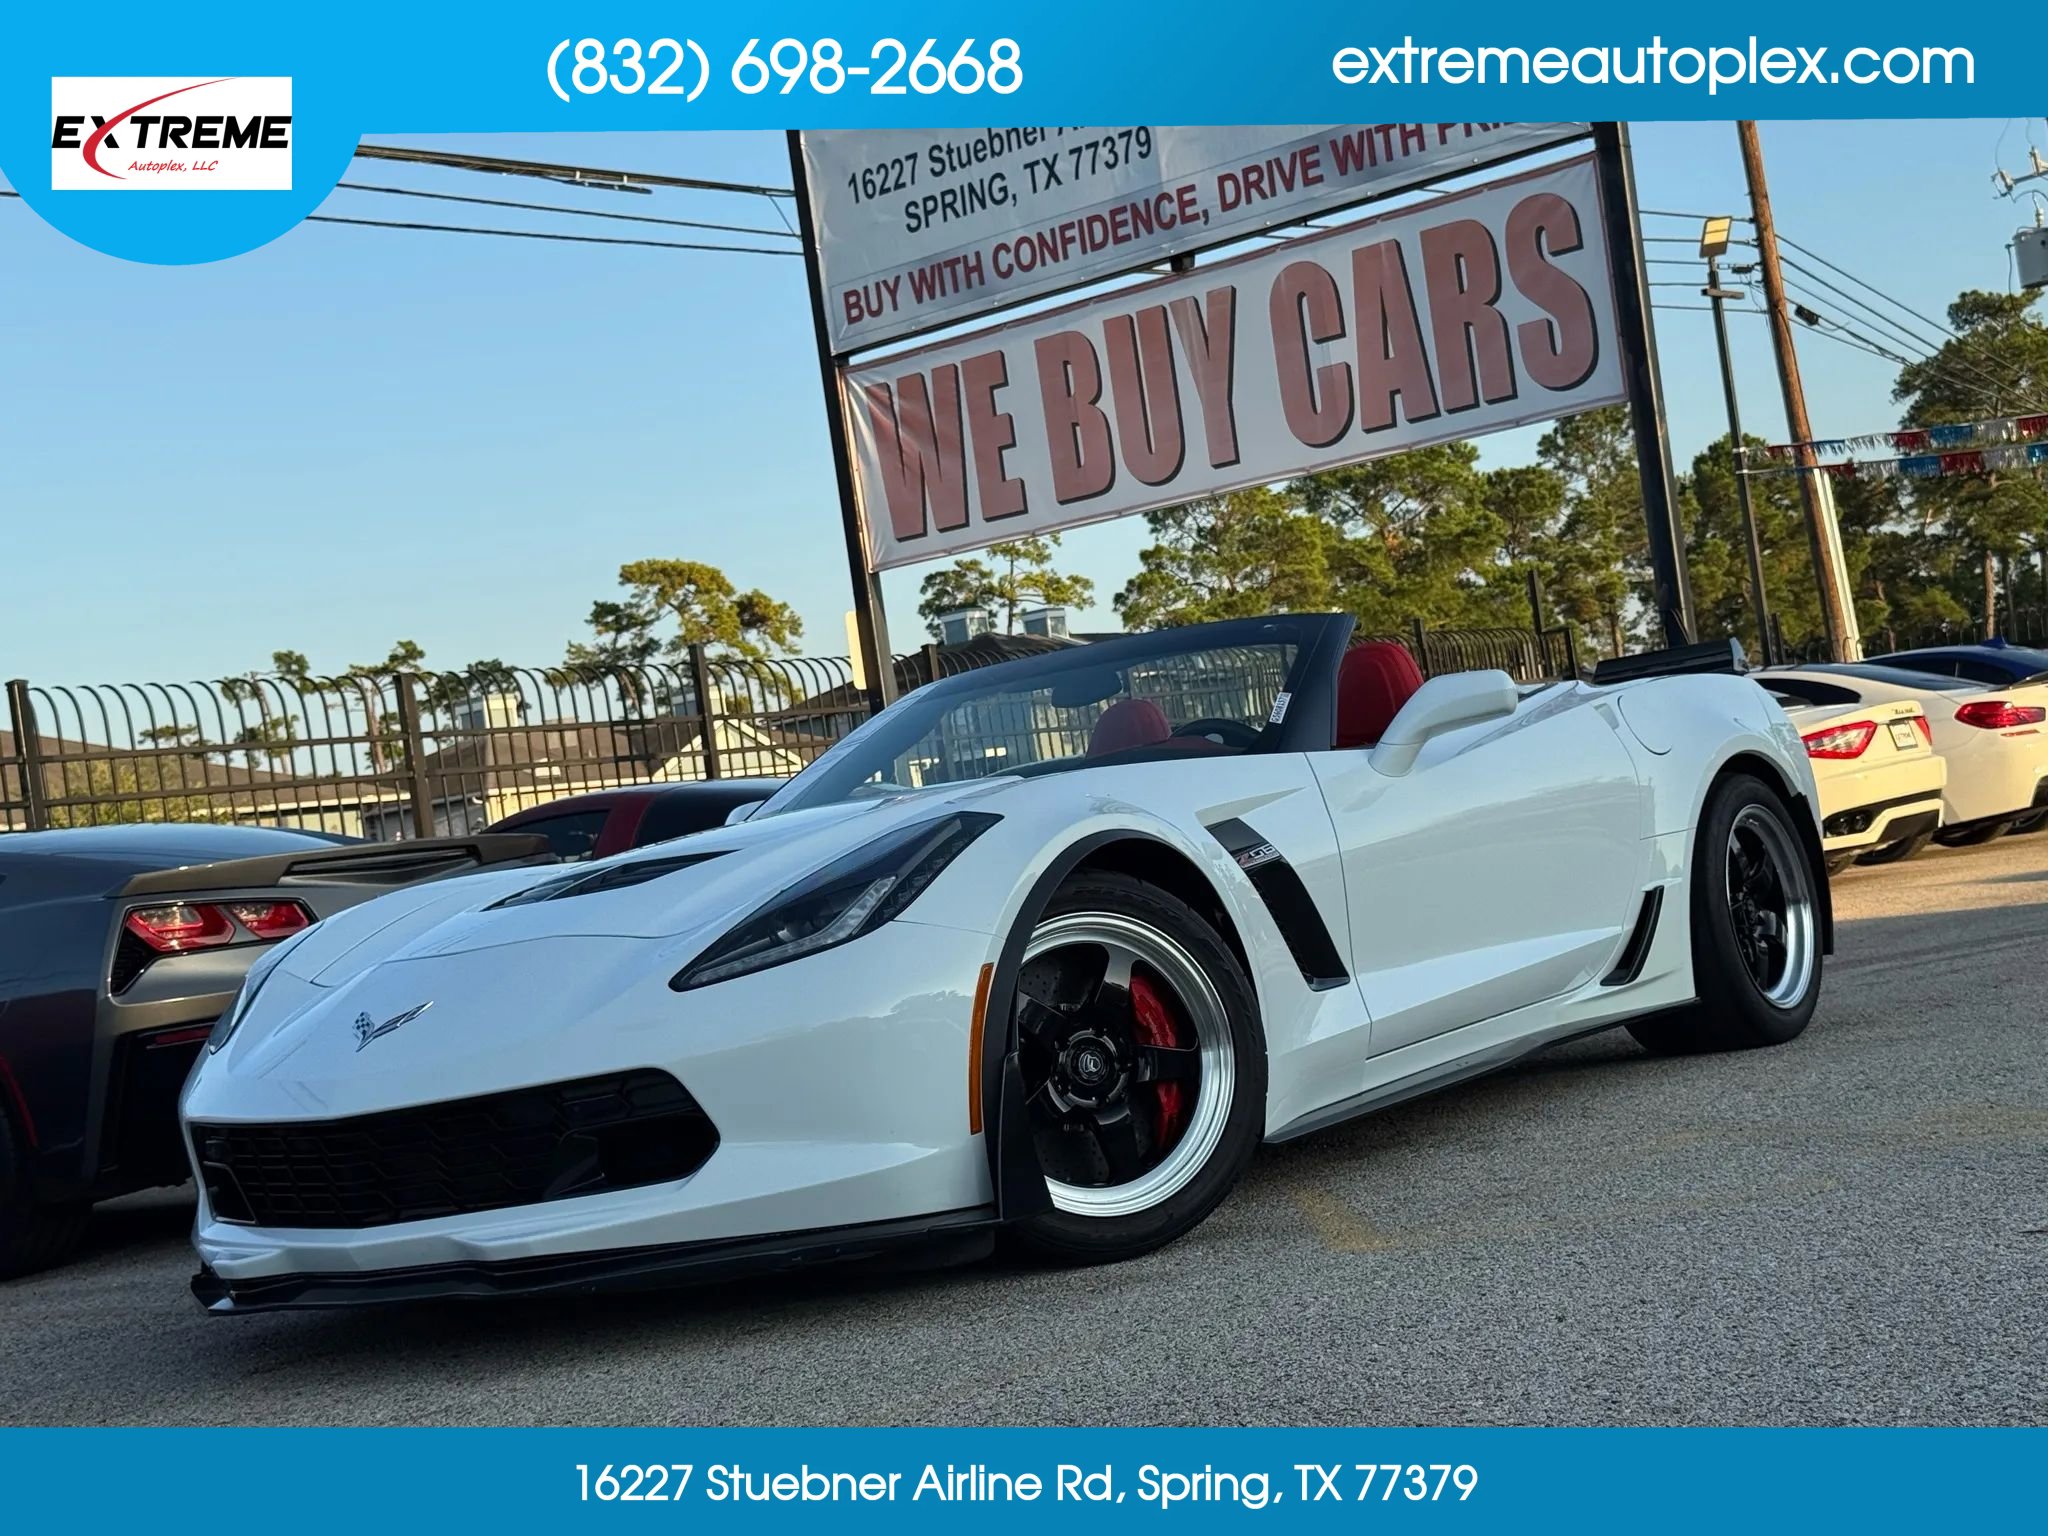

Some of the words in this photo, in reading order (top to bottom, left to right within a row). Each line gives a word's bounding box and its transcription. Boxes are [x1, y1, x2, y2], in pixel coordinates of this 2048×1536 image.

[843, 276, 901, 325] BUY
[908, 251, 985, 304] WITH
[992, 184, 1209, 280] CONFIDENCE,
[1217, 145, 1324, 213] DRIVE
[1329, 123, 1425, 176] WITH
[848, 152, 918, 204] 16227
[905, 172, 1017, 233] SPRING,
[1023, 153, 1063, 195] TX
[1068, 126, 1151, 180] 77379
[864, 350, 1029, 543] WE
[1034, 284, 1240, 505] BUY
[1269, 193, 1599, 449] CARS
